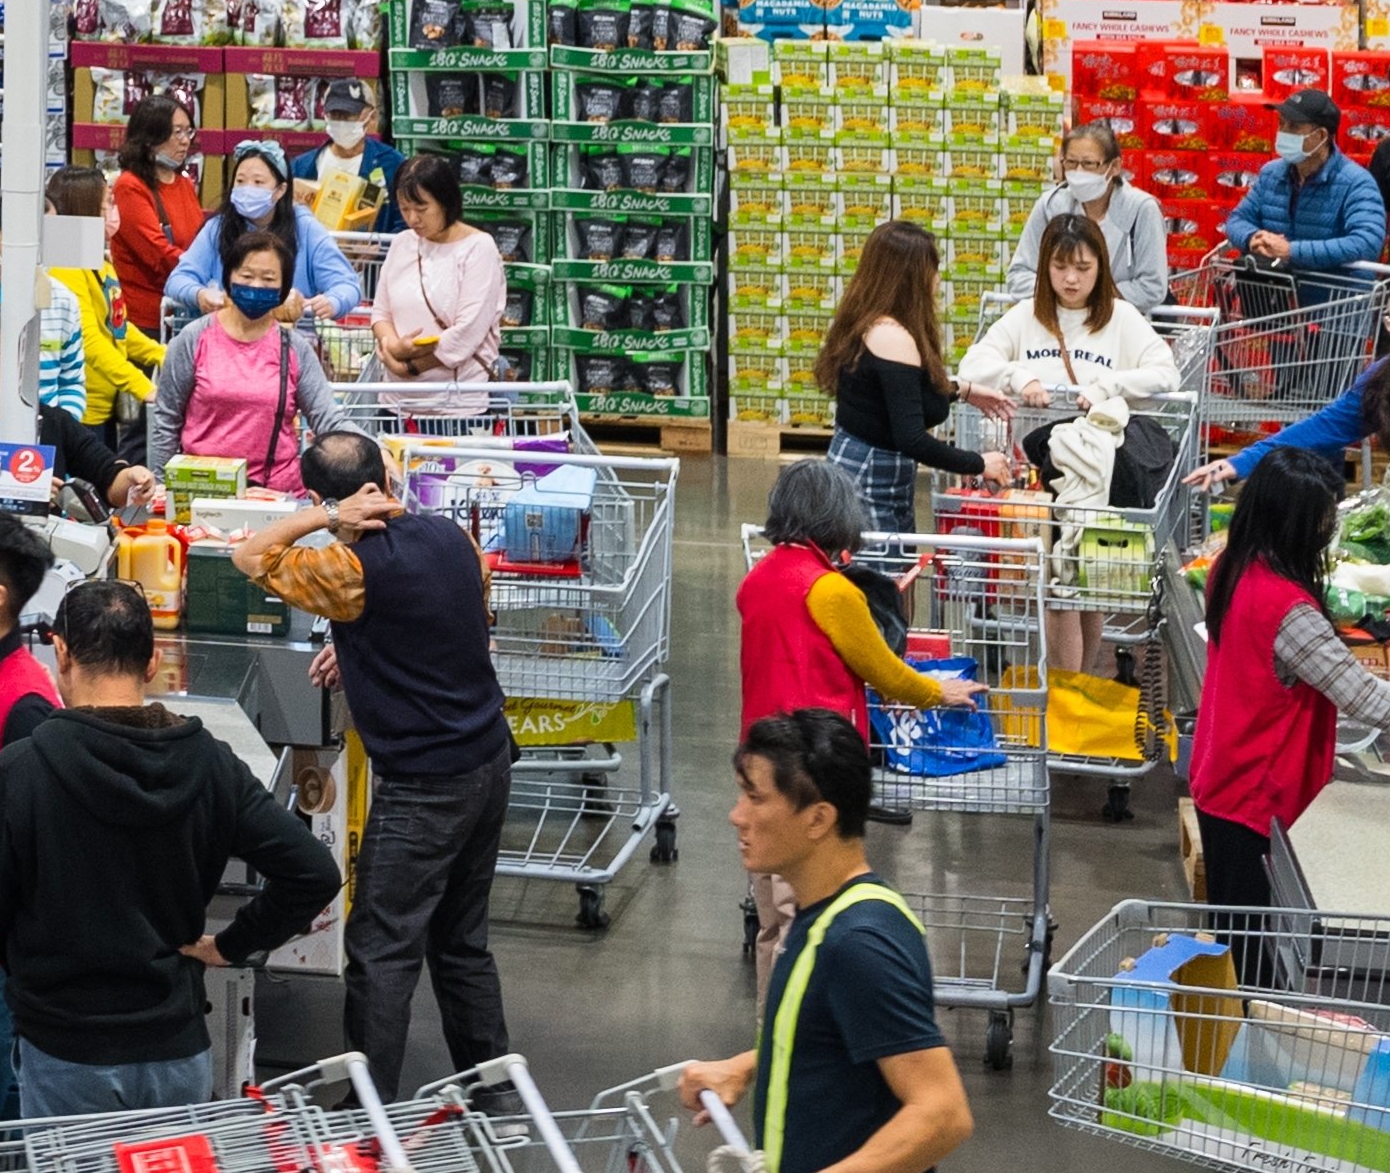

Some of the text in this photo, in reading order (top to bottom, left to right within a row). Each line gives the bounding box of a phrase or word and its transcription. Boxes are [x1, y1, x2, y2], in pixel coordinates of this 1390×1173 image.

[756, 0, 810, 8] MACADAMIA
[843, 3, 897, 11] MACADAMIA
[772, 8, 797, 16] NUTS
[859, 11, 883, 19] NUTS
[1072, 22, 1169, 33] FANCY WHOLE CASHEWS
[1230, 28, 1328, 39] FANCY WHOLE CASHEWS
[1074, 349, 1113, 369] REAL
[196, 511, 223, 519] logitech
[510, 711, 567, 733] EARS
[1241, 1141, 1289, 1169] Fresh
